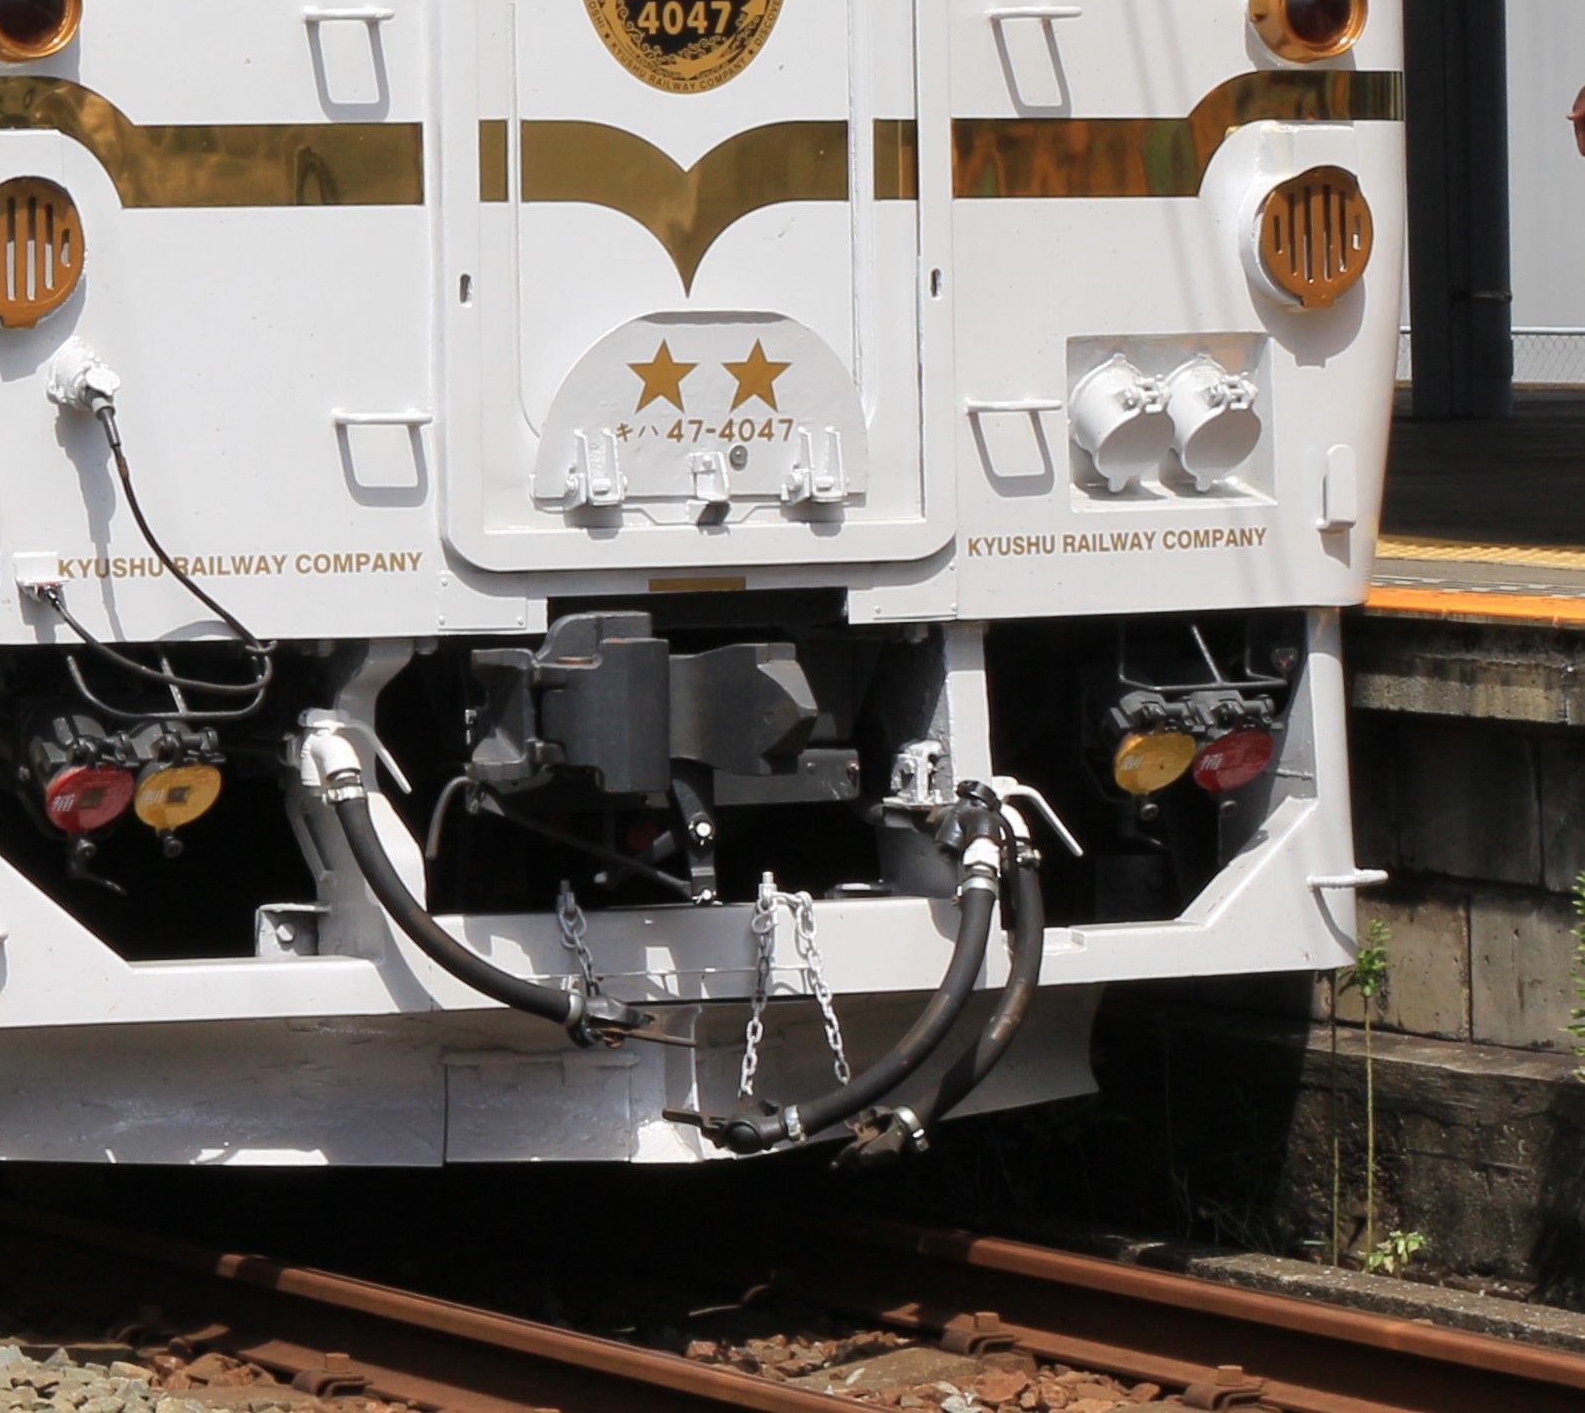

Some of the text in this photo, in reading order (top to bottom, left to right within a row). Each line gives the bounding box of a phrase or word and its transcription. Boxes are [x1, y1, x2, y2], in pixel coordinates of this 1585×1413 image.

[637, 0, 732, 35] 4047
[649, 73, 696, 91] RAILWAY
[699, 58, 746, 89] COMPANY
[967, 527, 1268, 557] KYUSHU RAILWAY COMPANY
[57, 551, 423, 580] KYUSHU RAILWAY COMPANY
